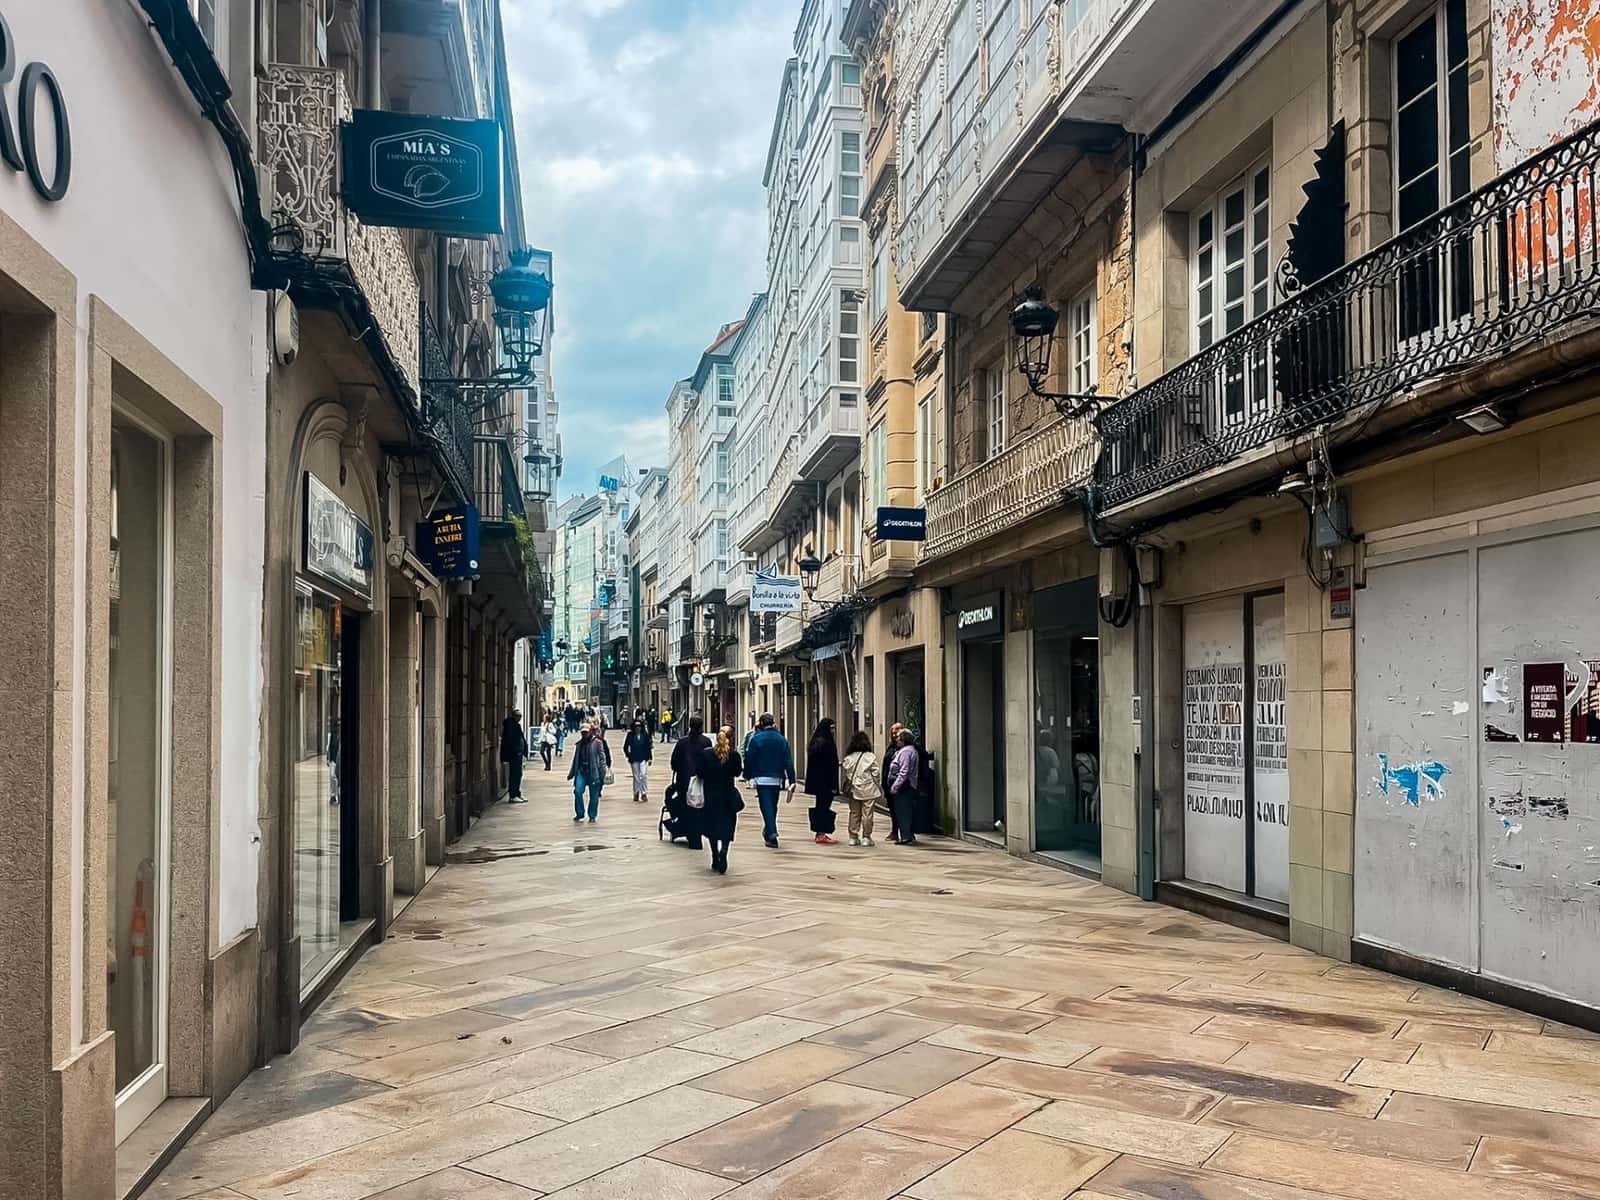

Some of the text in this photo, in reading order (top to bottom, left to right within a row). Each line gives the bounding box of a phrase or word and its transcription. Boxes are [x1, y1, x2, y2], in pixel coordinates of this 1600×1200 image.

[891, 519, 923, 528] DECATHLON
[964, 606, 993, 625] DECATHLON
[1186, 667, 1242, 685] ESTAMOS LIANDO
[1186, 686, 1199, 702] UNA
[1200, 686, 1215, 702] MUY
[1187, 703, 1197, 724] TE
[1199, 704, 1210, 724] VA
[1212, 704, 1218, 724] A
[1186, 725, 1194, 739] EL
[1187, 740, 1207, 754] CUANDO
[1187, 794, 1208, 813] PLAZA
